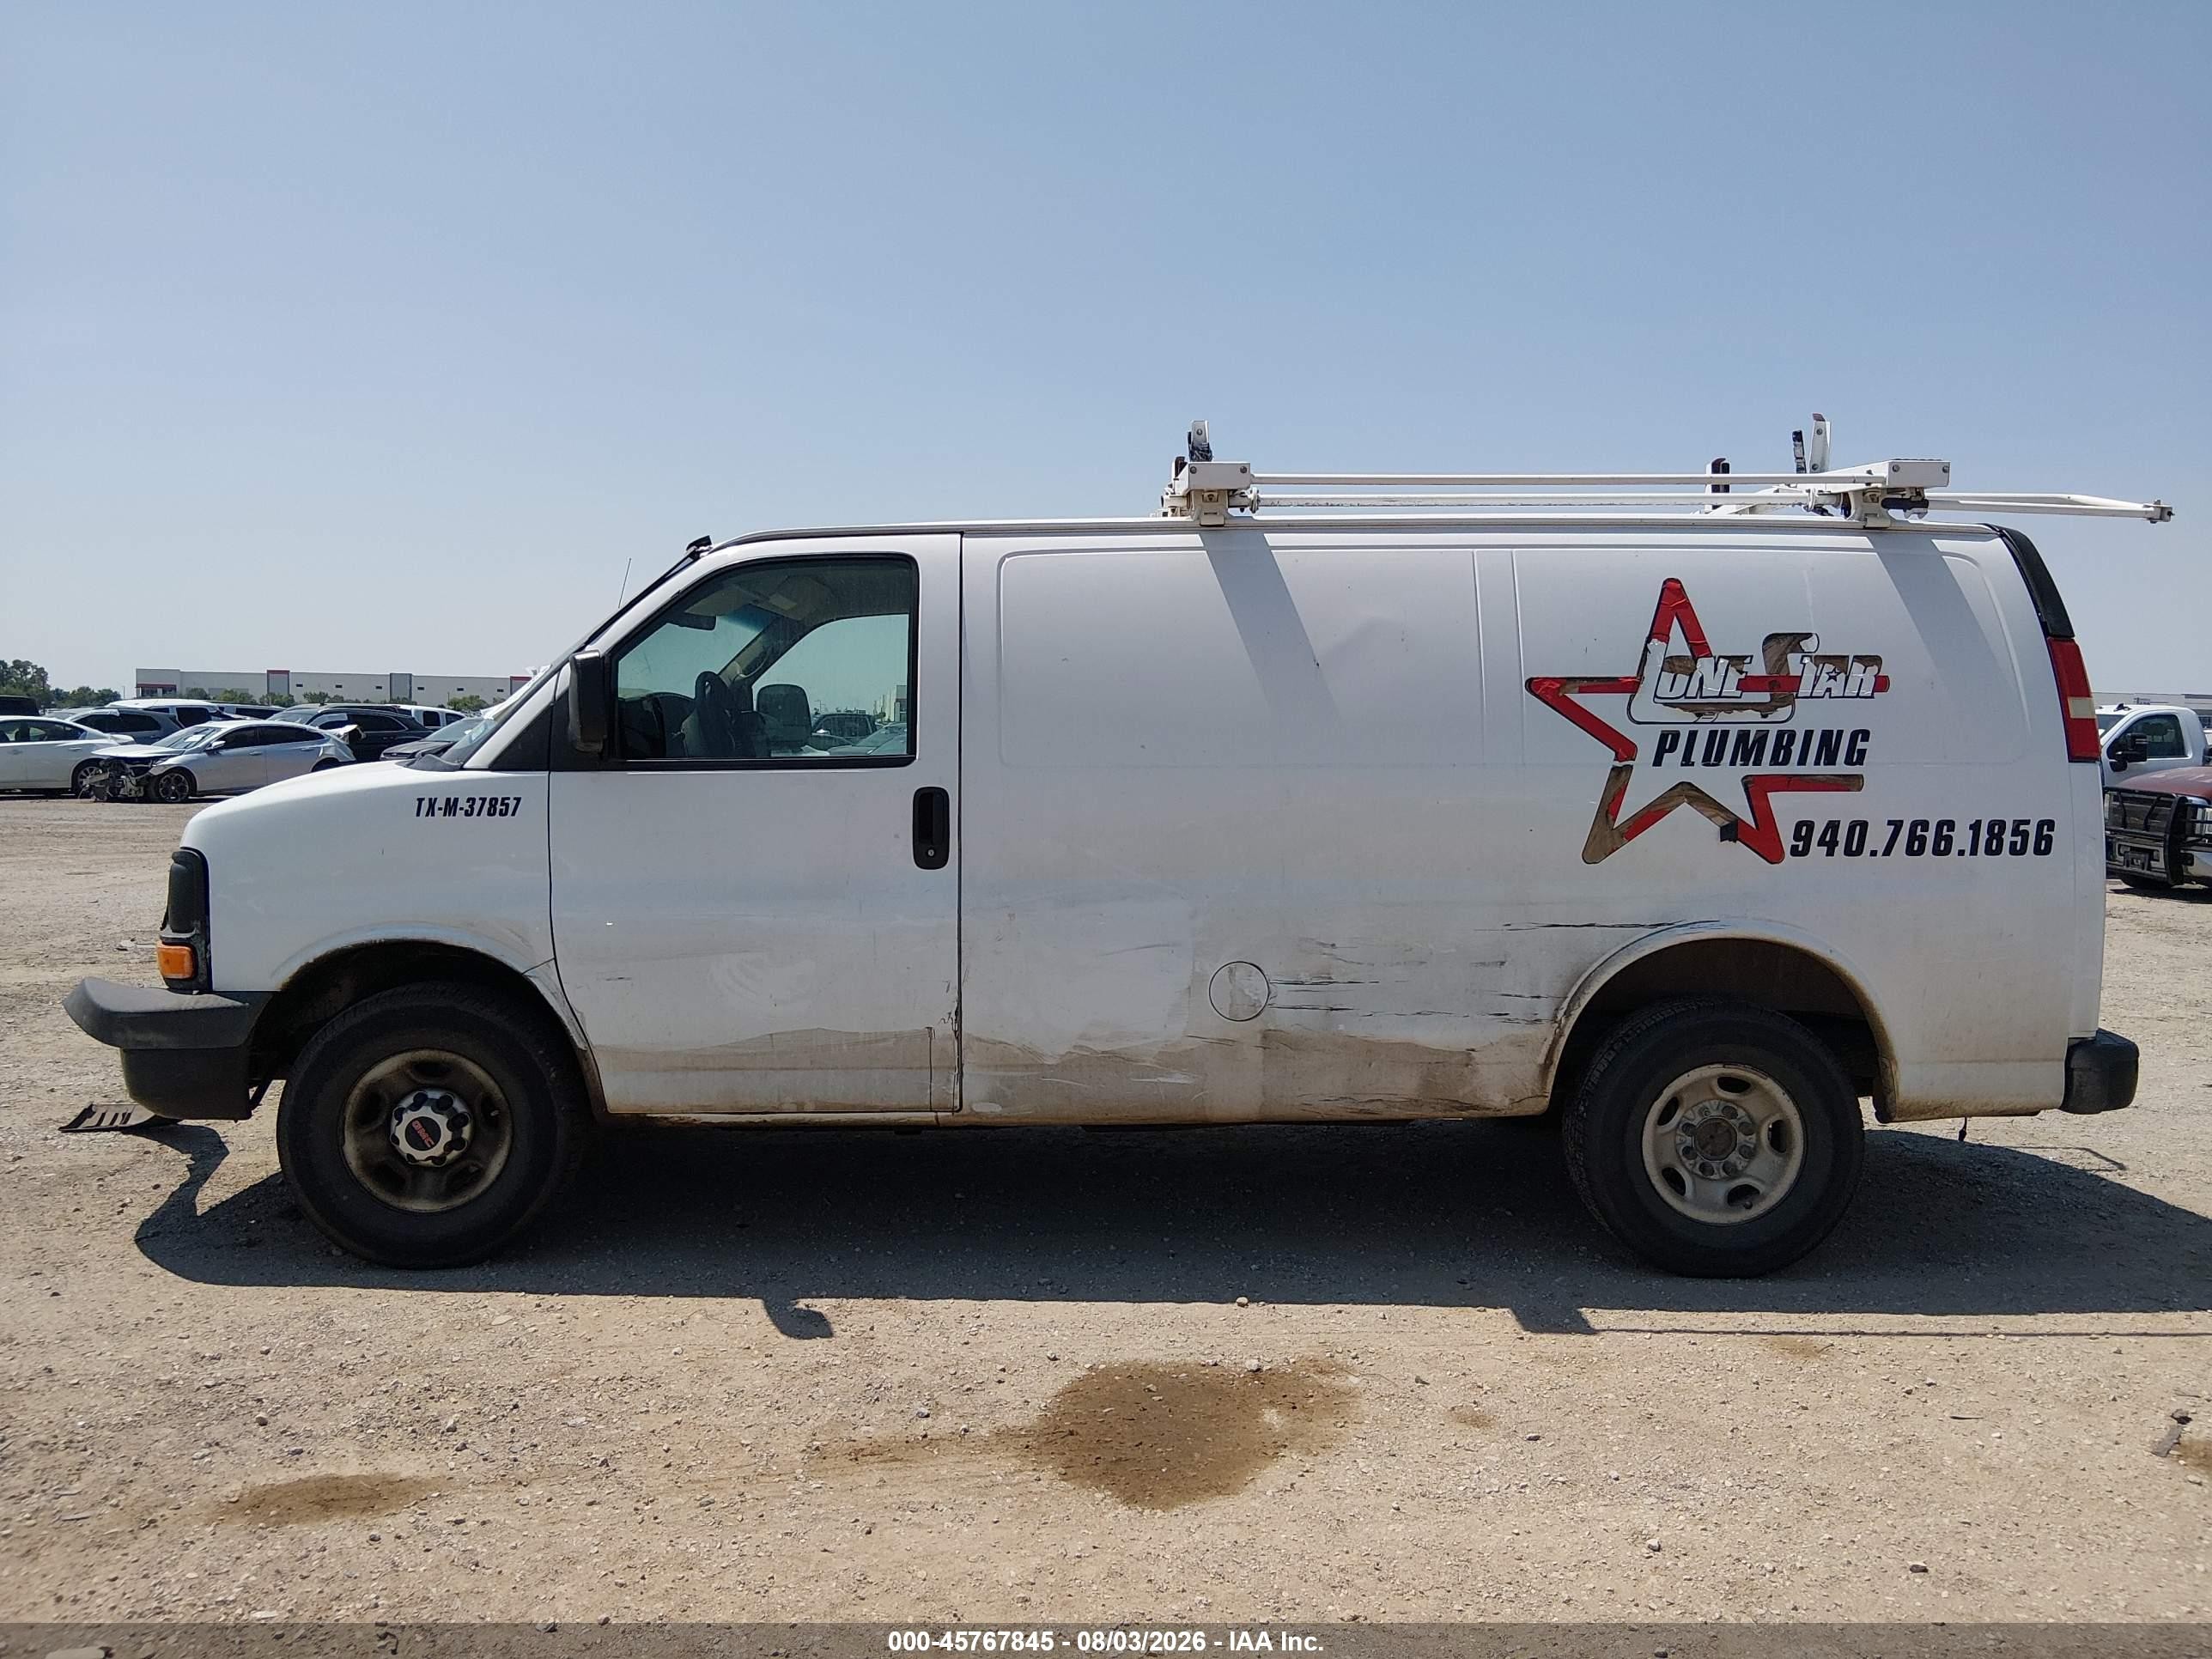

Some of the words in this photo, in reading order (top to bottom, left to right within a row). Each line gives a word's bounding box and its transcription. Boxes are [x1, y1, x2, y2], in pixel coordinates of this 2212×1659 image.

[1651, 728, 1871, 768] PLUMBING
[416, 796, 522, 817] TX-M-37857
[1789, 818, 2056, 858] 940.766.1856
[411, 1119, 435, 1148] GMC
